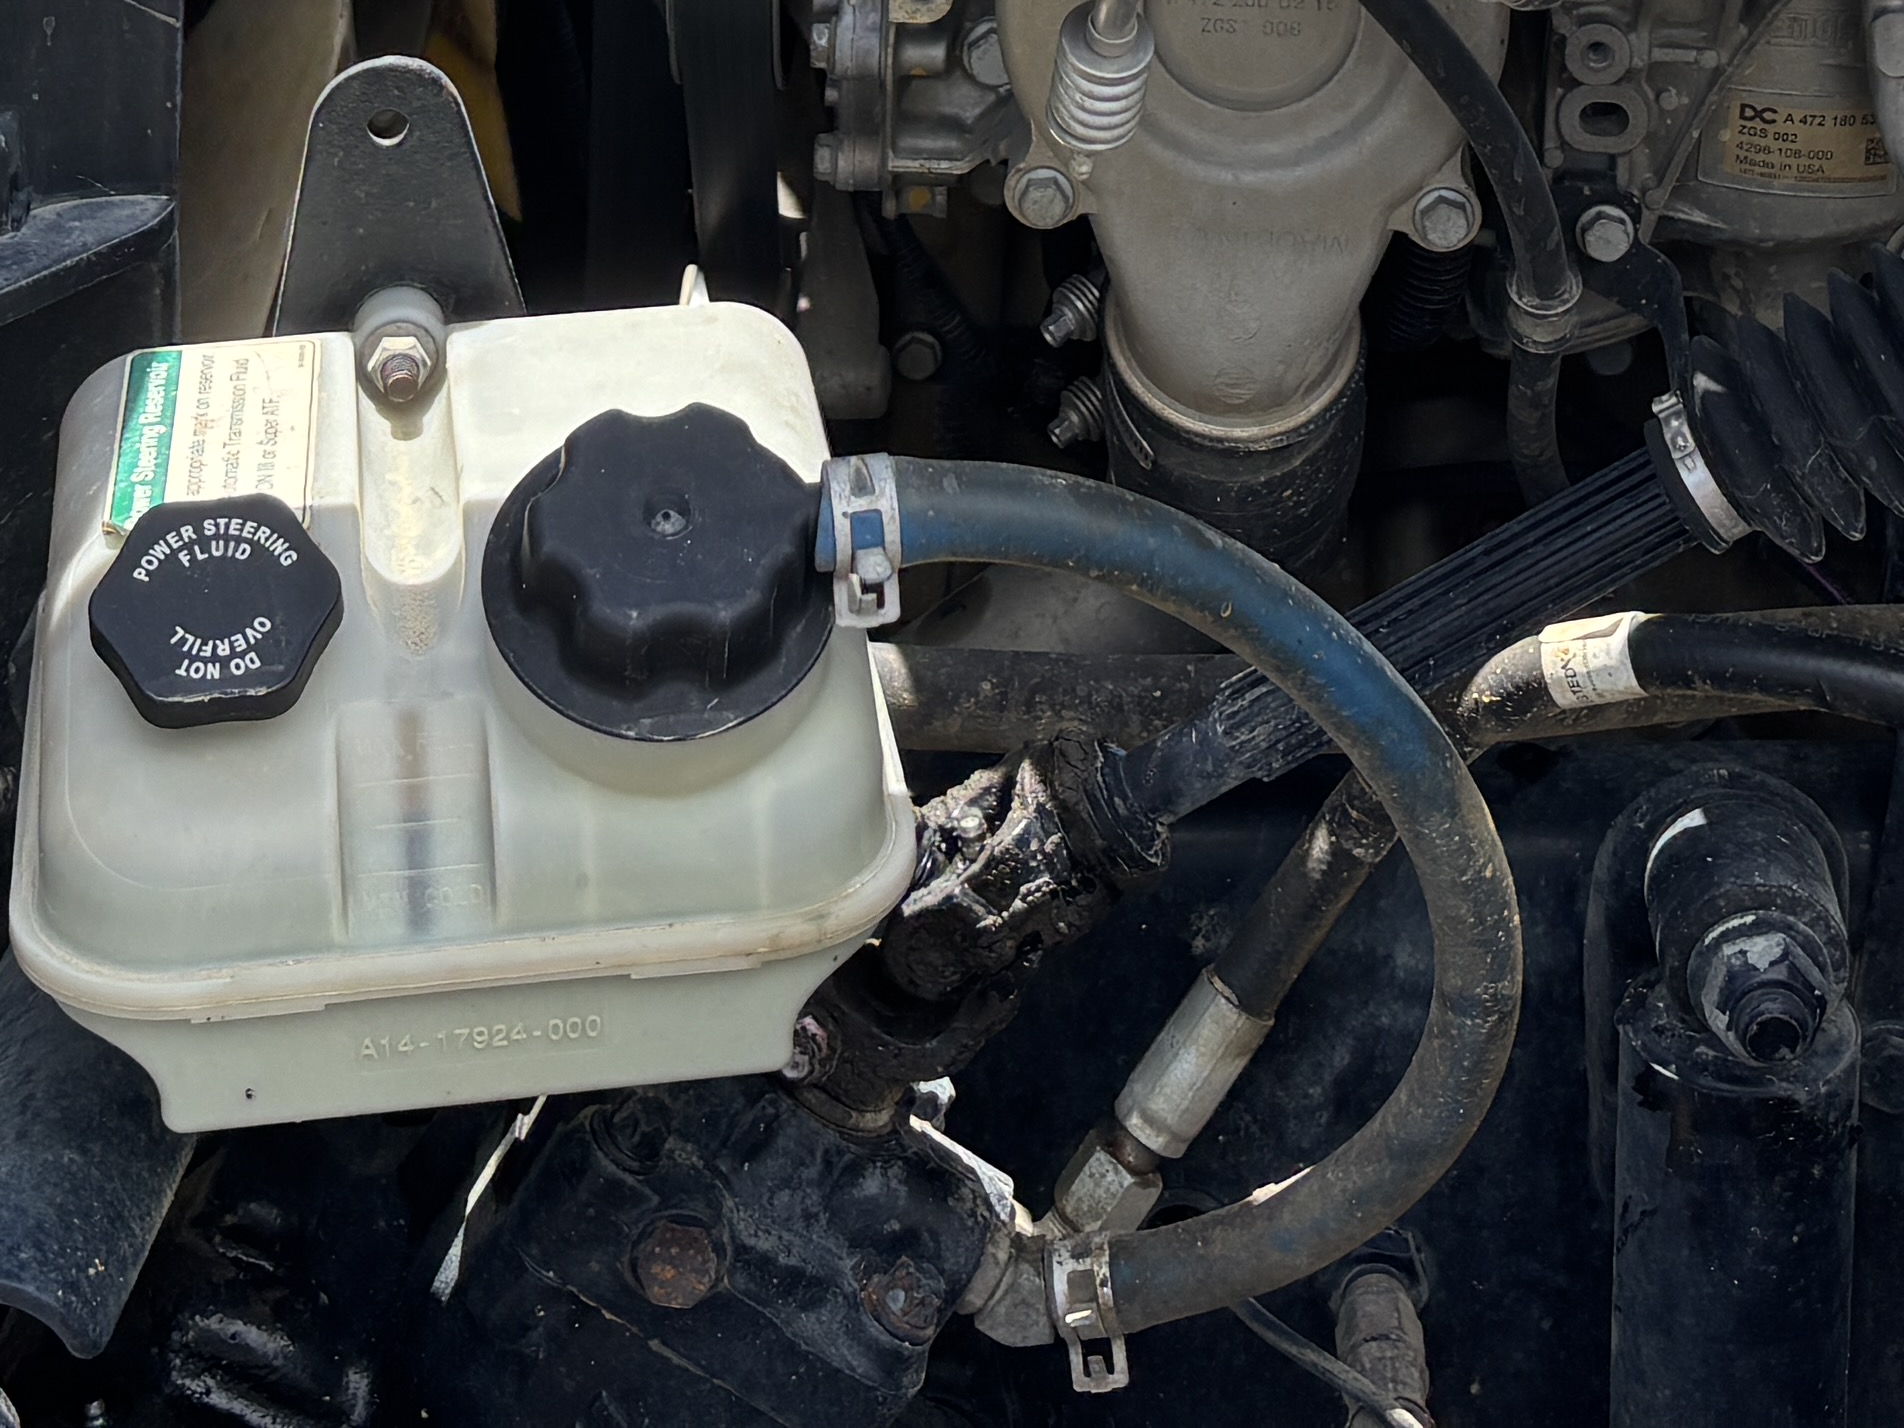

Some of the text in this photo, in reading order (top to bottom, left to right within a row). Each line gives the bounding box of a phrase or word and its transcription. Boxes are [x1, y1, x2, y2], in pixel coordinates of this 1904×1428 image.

[1200, 17, 1239, 34] ZGS
[1739, 102, 1778, 125] DC
[1783, 113, 1795, 125] A
[1799, 114, 1826, 127] 472
[1737, 124, 1769, 138] ZGS
[1735, 154, 1825, 175] Made in USA
[137, 361, 170, 424] Reservoir
[131, 425, 167, 482] Steering
[132, 517, 298, 582] POWER STEERING
[178, 540, 252, 568] FLUID
[169, 616, 272, 657] OVERFILL
[175, 651, 261, 680] DO NOT
[360, 1014, 602, 1060] A14-17924-000
